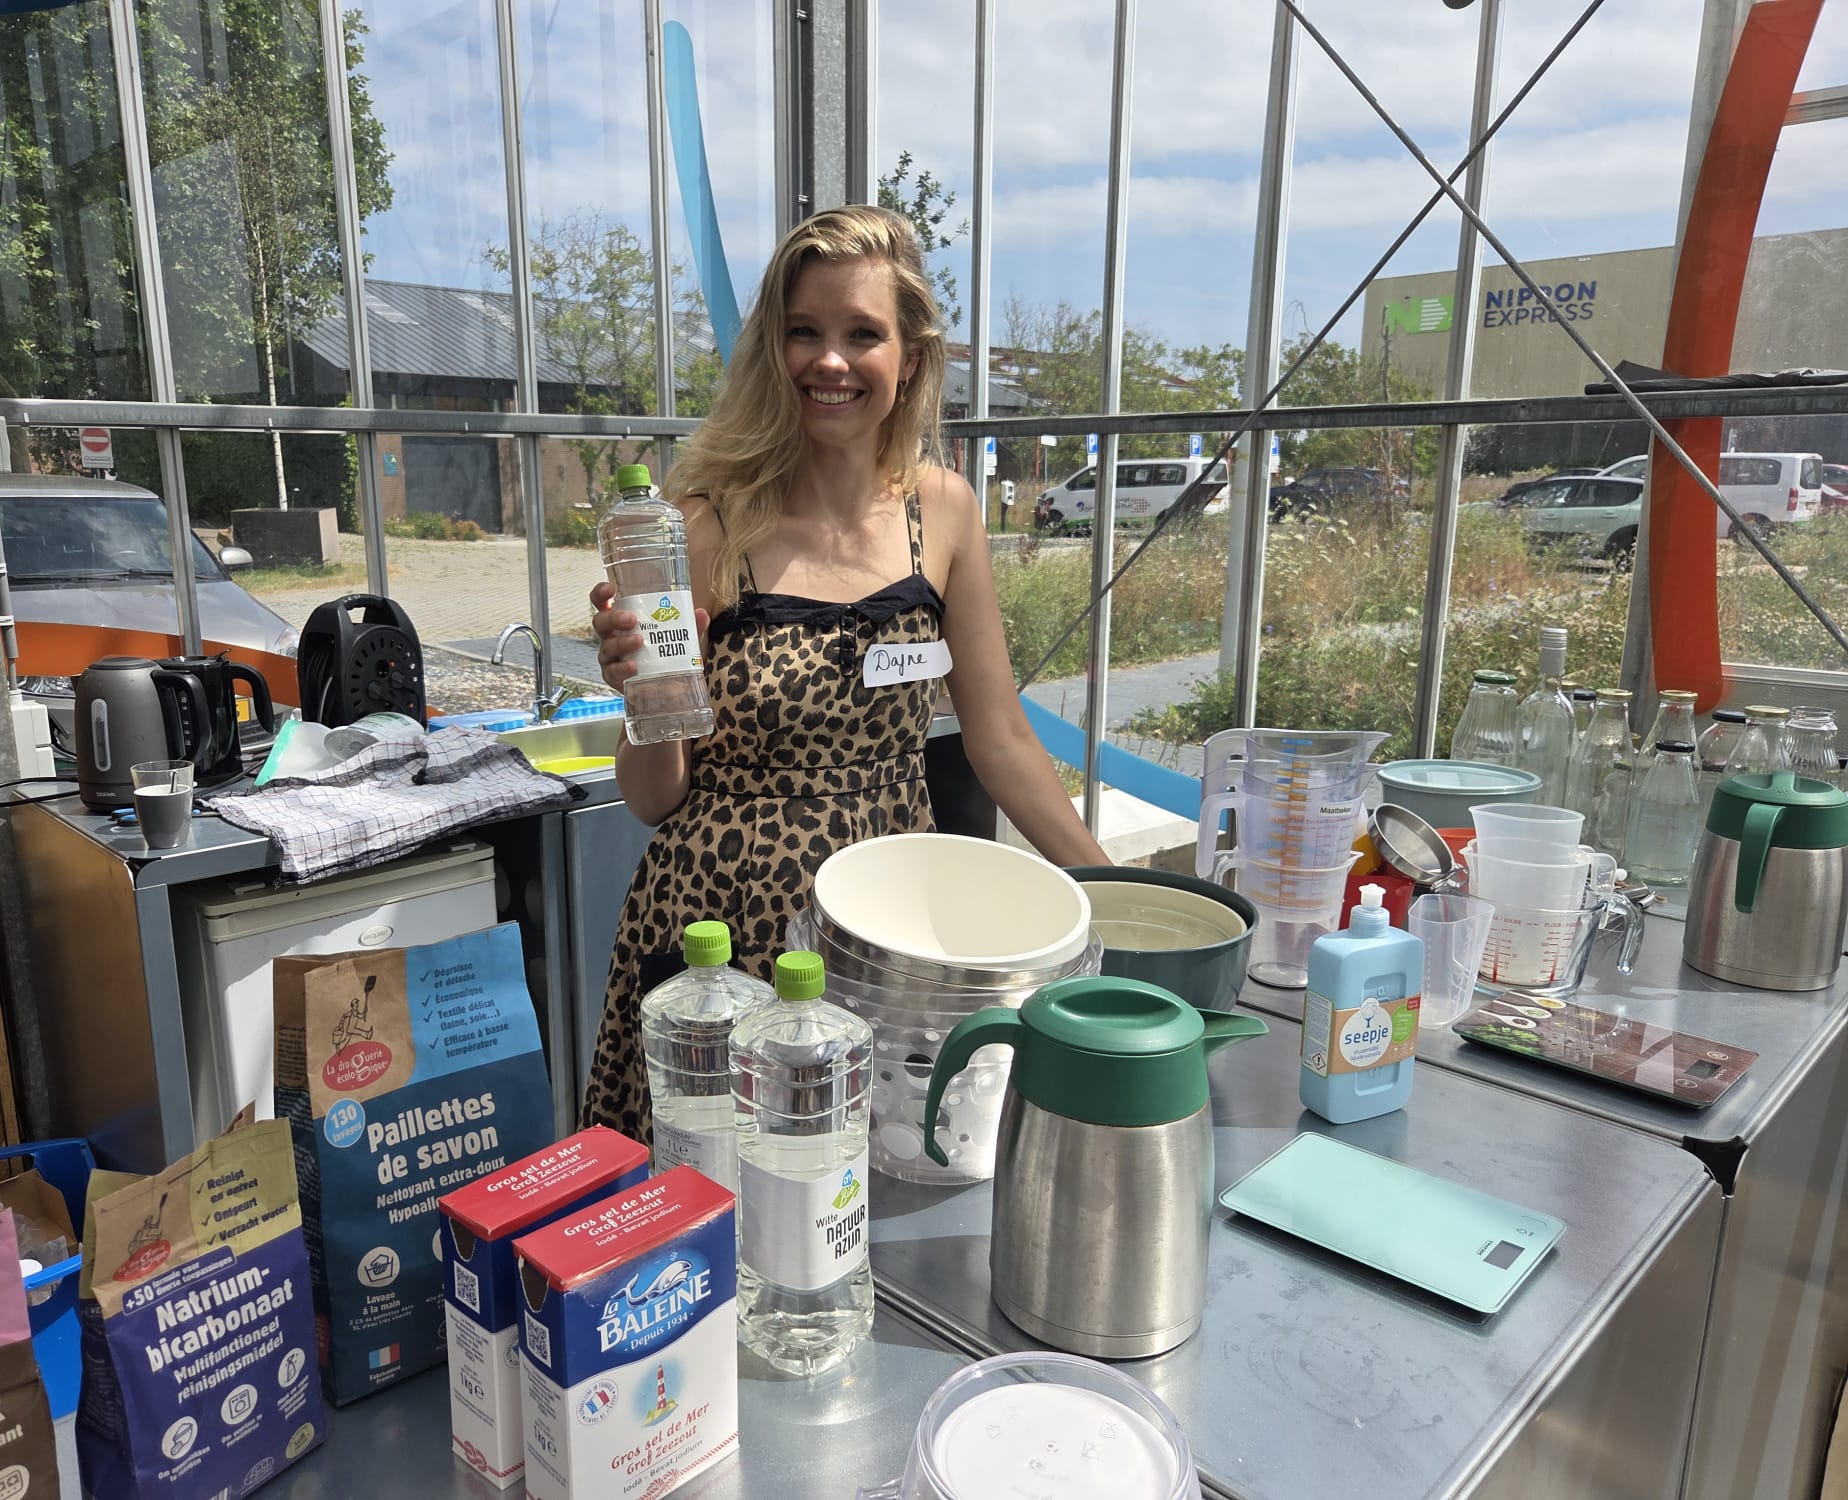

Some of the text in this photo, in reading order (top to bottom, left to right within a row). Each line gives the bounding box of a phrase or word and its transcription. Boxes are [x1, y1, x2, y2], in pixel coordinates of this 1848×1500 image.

[639, 622, 659, 631] Witte
[649, 628, 690, 645] NATUUR
[658, 643, 686, 658] AZIJN
[433, 962, 473, 979] Dégraisse
[434, 972, 477, 990] et détache
[435, 987, 484, 1004] Économique
[438, 1000, 496, 1020] Textile délicat
[440, 1018, 468, 1032] (laine,
[444, 1023, 509, 1047] Efficace à basse
[1344, 1025, 1388, 1045] seepje
[446, 1037, 498, 1058] température
[326, 1064, 335, 1075] La
[331, 1104, 357, 1129] 130
[367, 1092, 496, 1154] Paillettes
[377, 1126, 499, 1185] de savon
[487, 1142, 583, 1192] Gros sel de Mer
[207, 1169, 245, 1190] Reinigt
[376, 1156, 506, 1209] Nettoyant extra-doux
[510, 1154, 581, 1191] Grof Zeezout
[544, 1173, 568, 1188] Bevat
[569, 1158, 599, 1176] jodium
[210, 1178, 259, 1204] en ontvet
[213, 1197, 258, 1222] Ontgeurt
[219, 1203, 289, 1241] Verzacht water
[564, 1185, 667, 1237] Gros sel de Mer
[588, 1198, 664, 1236] Grof Zeezout
[623, 1218, 649, 1233] Bevat
[650, 1203, 682, 1222] jodium
[816, 1214, 839, 1229] Witte
[827, 1204, 866, 1245] NATUUR
[835, 1227, 861, 1260] AZIJN
[126, 1284, 154, 1309] +50
[155, 1266, 271, 1333] Natrium-
[362, 1300, 401, 1316] à la main
[366, 1292, 396, 1305] Lavage
[596, 1268, 712, 1353] BALEINE
[600, 1299, 619, 1320] La
[145, 1278, 293, 1373] bicarbonaat
[630, 1326, 664, 1350] Depuis
[666, 1311, 688, 1331] 1934
[173, 1315, 280, 1383] Multifunctioneel
[177, 1331, 284, 1405] reinigingsmiddel
[611, 1402, 709, 1470] Gros sel de Mer
[627, 1425, 697, 1475] Grof Zeezout
[623, 1478, 643, 1495] Iodé
[650, 1459, 674, 1478] Bevat
[674, 1440, 704, 1463] jodium
